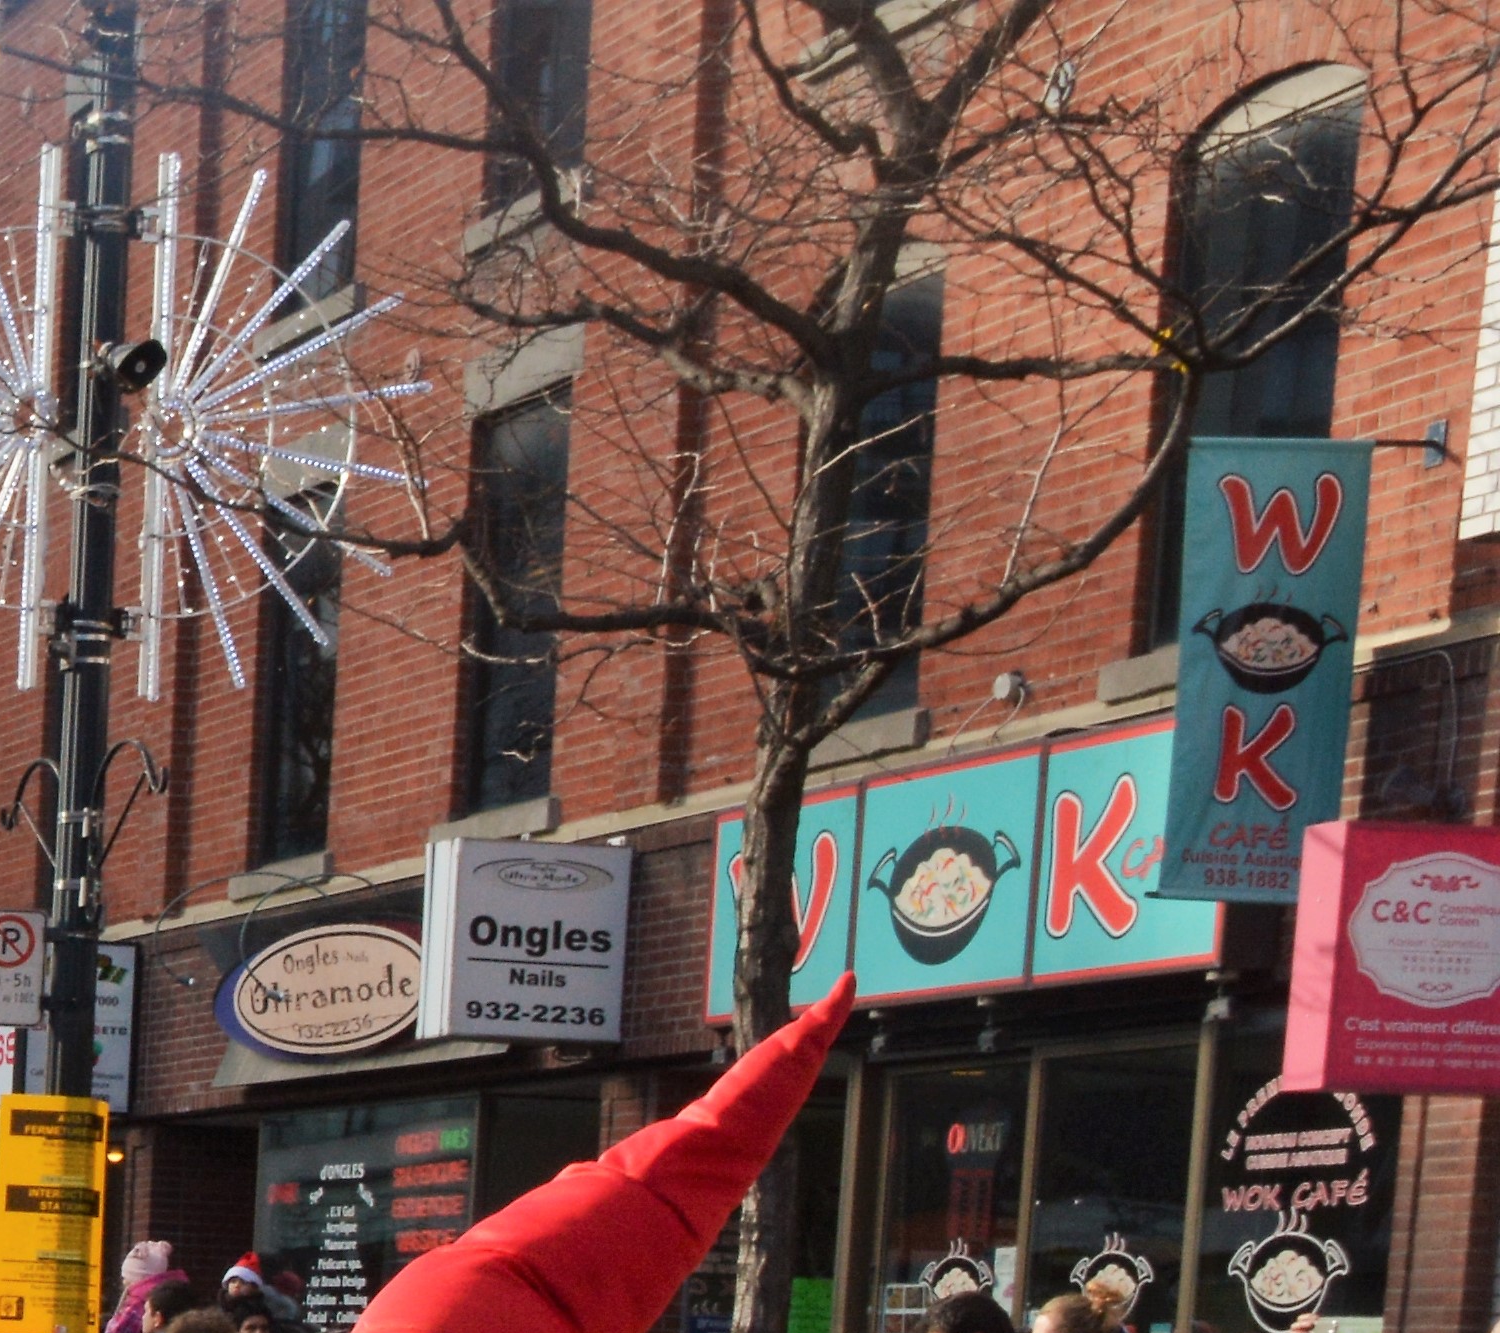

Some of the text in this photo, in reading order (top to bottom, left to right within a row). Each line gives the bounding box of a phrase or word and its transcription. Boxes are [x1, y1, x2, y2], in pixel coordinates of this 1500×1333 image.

[1208, 815, 1290, 851] CAFÉ
[1371, 899, 1434, 925] C&C
[469, 914, 612, 958] Ongles
[282, 943, 339, 975] Ongles
[509, 967, 567, 989] Nails
[466, 1000, 606, 1027] 932-2236
[1221, 1167, 1369, 1212] WOK CAFÉ
